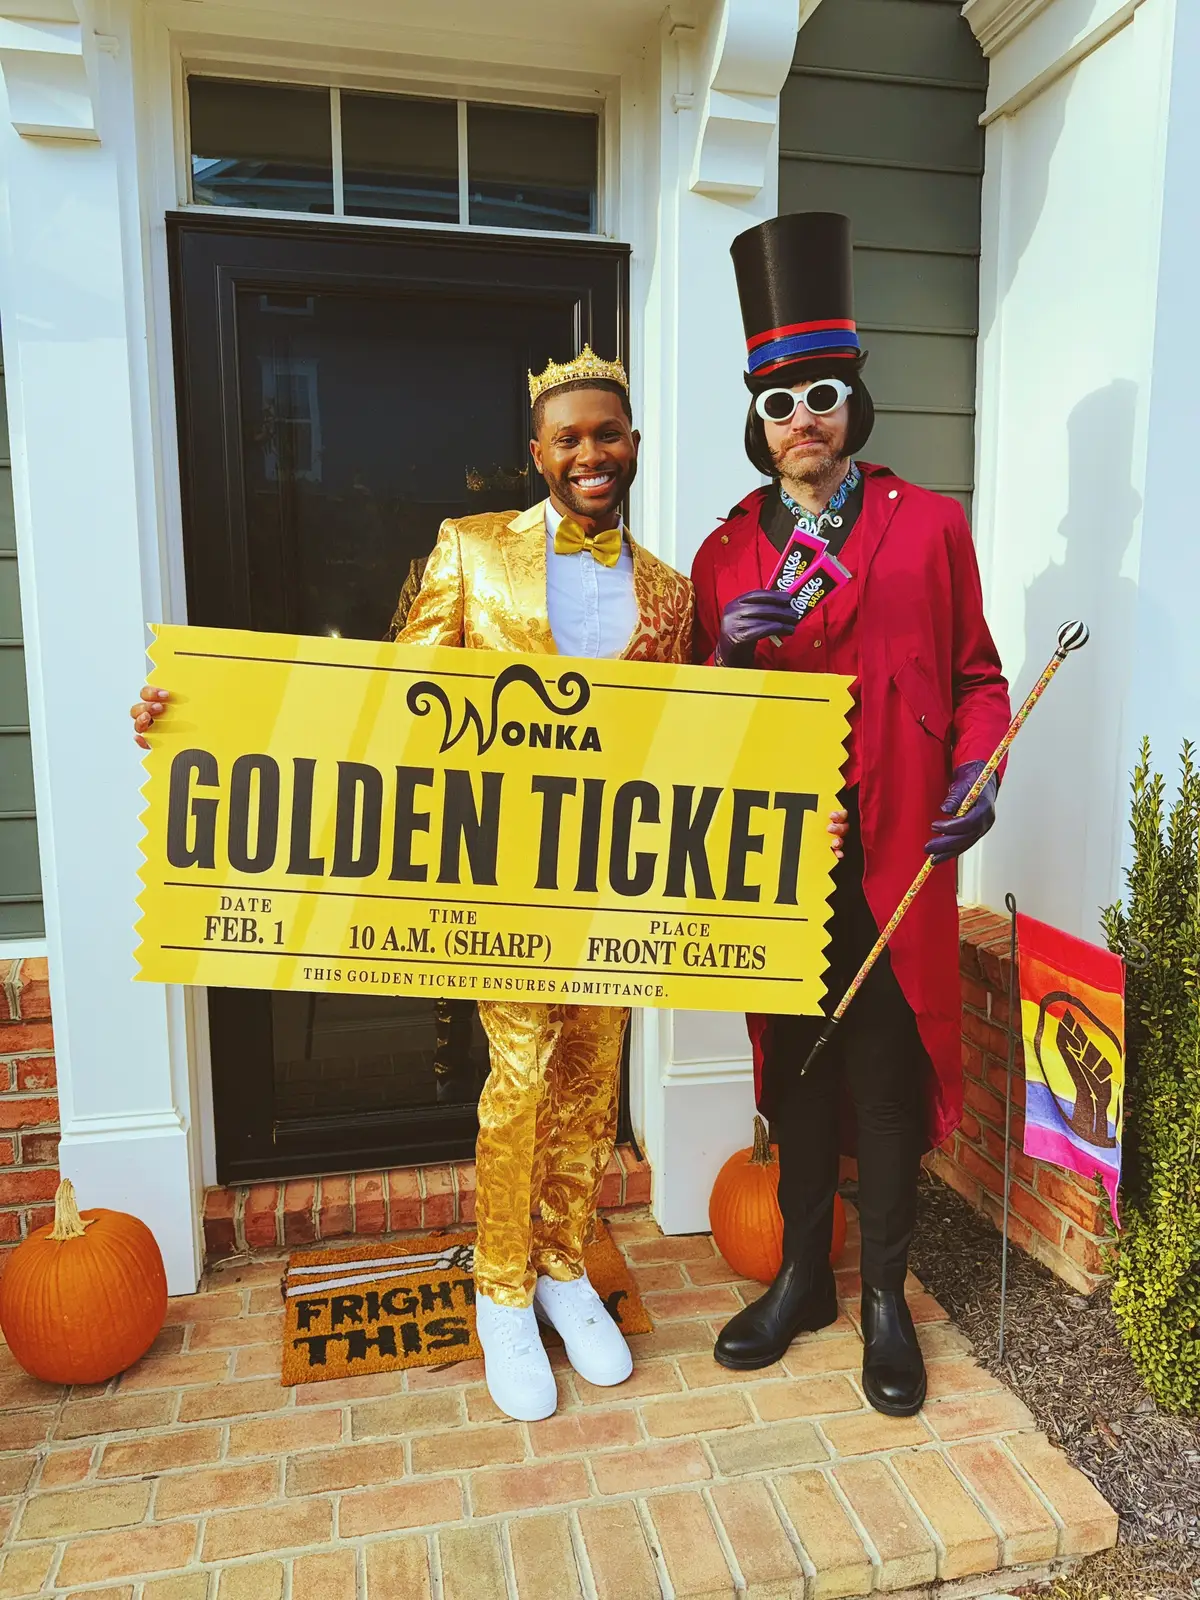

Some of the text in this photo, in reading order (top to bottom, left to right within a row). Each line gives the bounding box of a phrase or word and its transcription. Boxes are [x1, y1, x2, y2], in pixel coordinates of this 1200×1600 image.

[795, 560, 808, 580] AR
[166, 748, 819, 906] GOLDEN TICKET
[220, 895, 272, 913] DATE
[429, 908, 477, 925] TIME
[203, 915, 285, 945] FEB. 1
[349, 925, 553, 962] 10 A.M. (SHARP)
[649, 920, 711, 937] PLACE
[586, 936, 767, 971] FRONT GATES
[303, 966, 669, 997] THIS GOLDEN TICKET ENSURES ADMITTANCE.
[295, 1277, 475, 1331] FRIGHT
[293, 1315, 470, 1367] THIS
